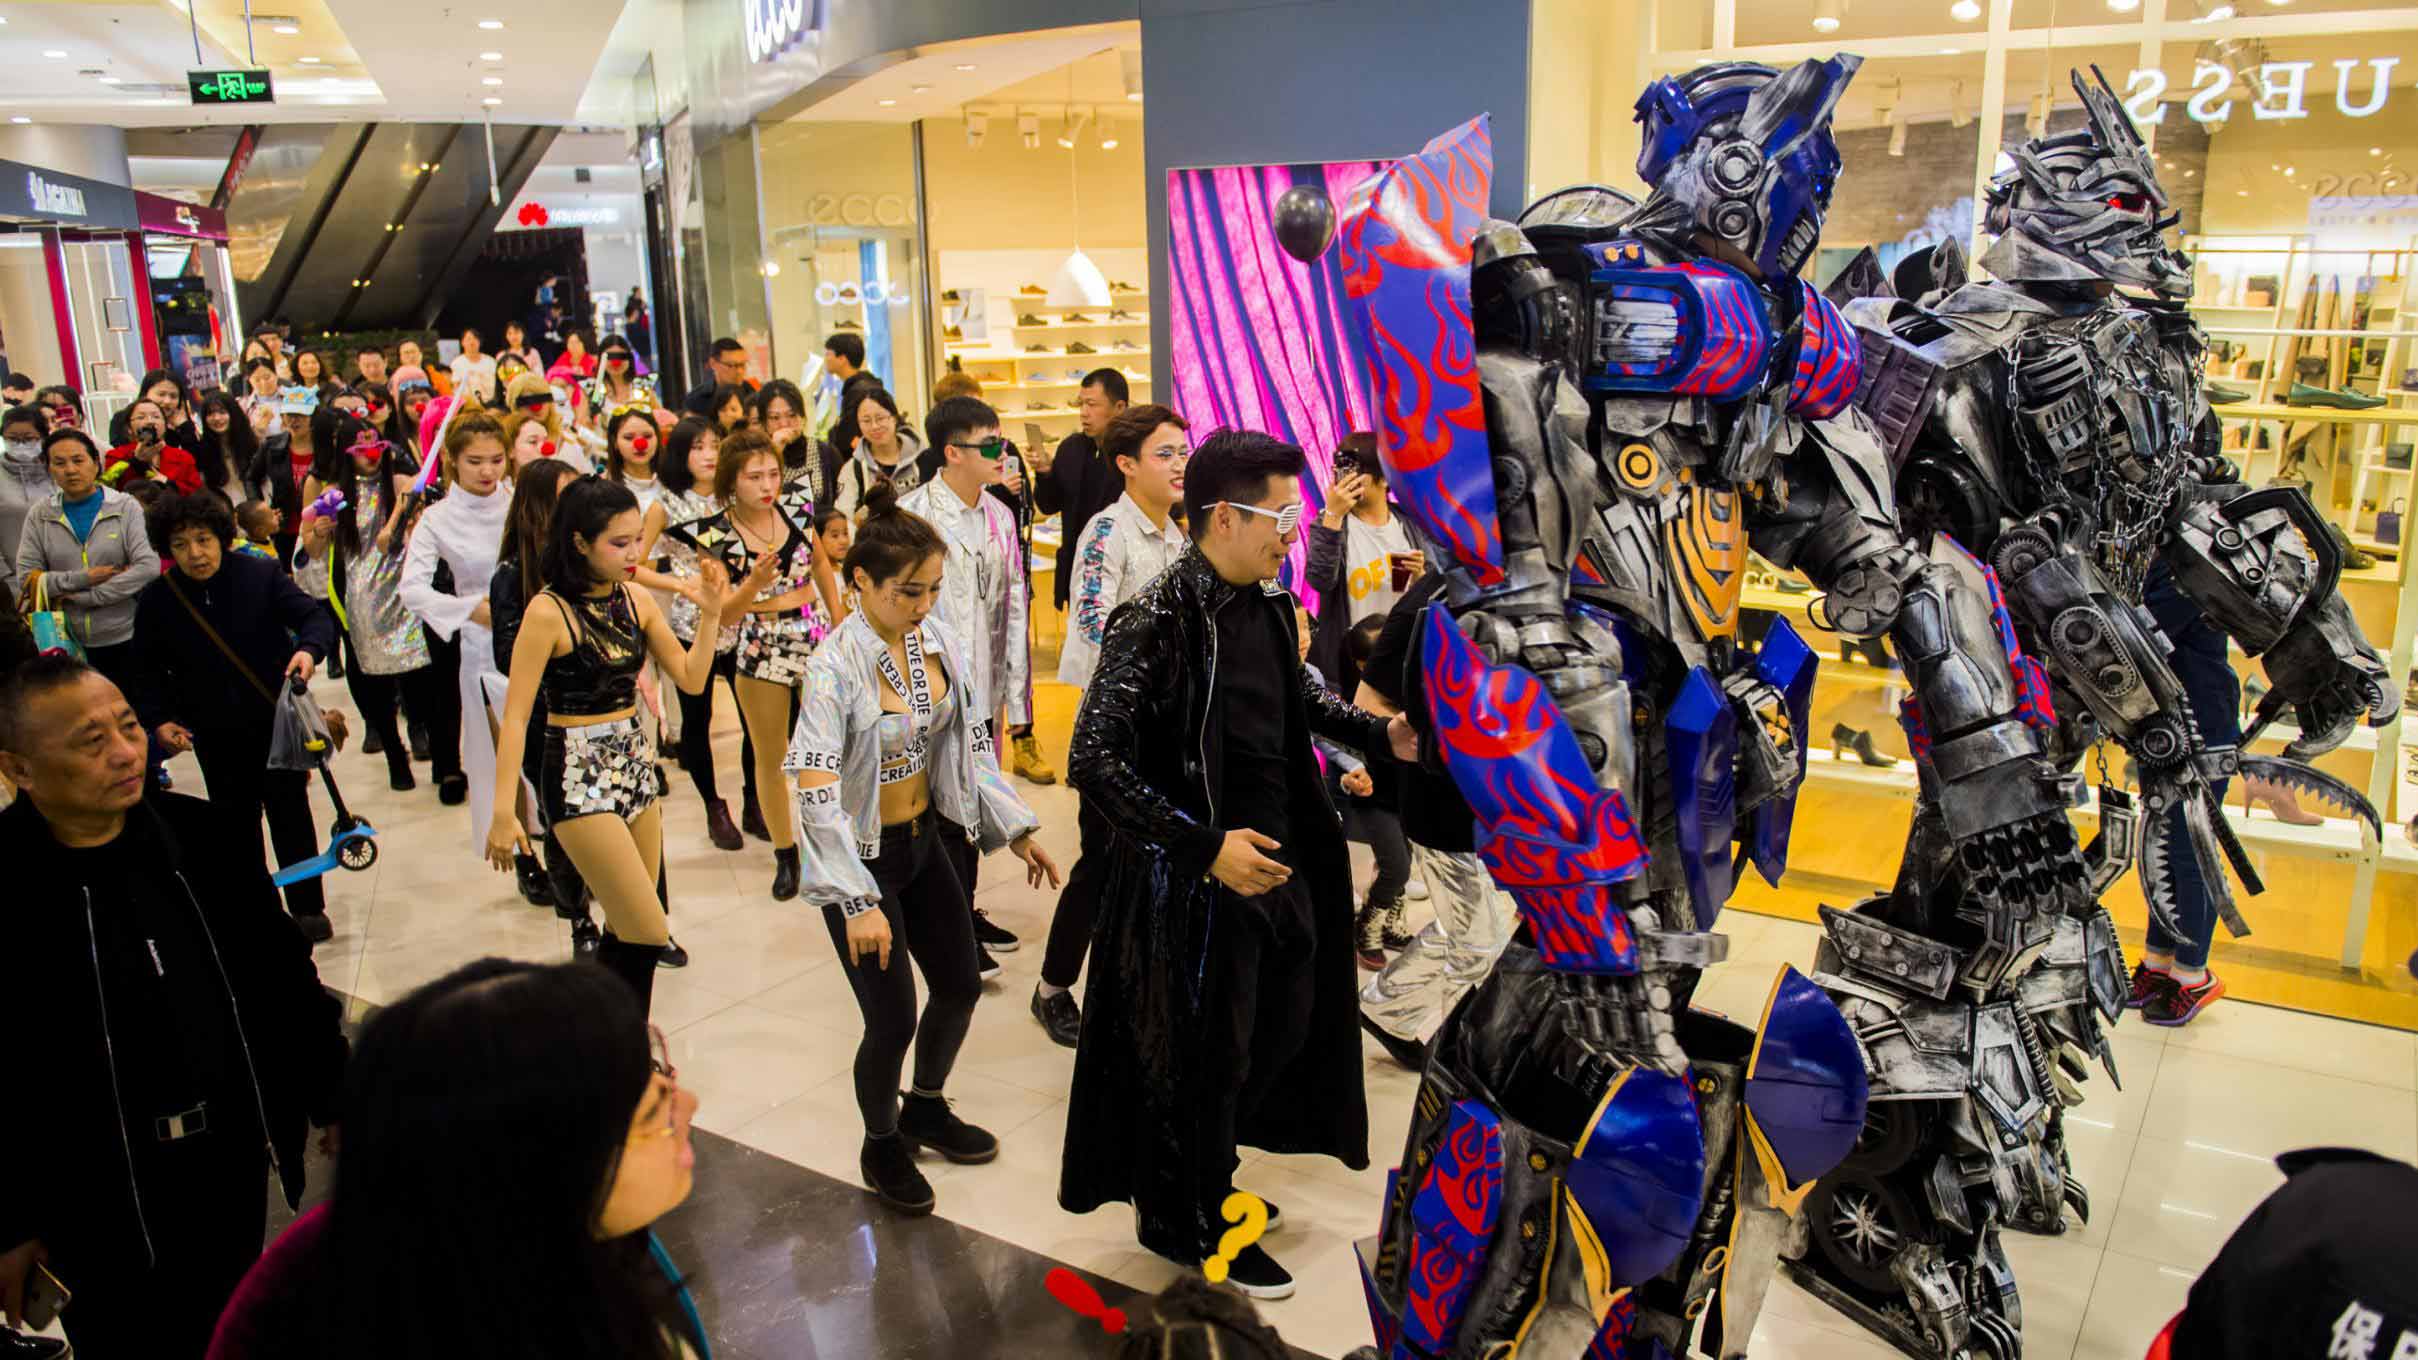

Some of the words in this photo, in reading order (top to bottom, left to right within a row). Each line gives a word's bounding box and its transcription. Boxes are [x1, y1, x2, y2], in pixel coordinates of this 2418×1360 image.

[911, 668, 926, 689] OR
[915, 692, 931, 715] DIE
[804, 752, 823, 767] BE
[844, 897, 864, 917] BE
[2326, 1299, 2418, 1360] 保
